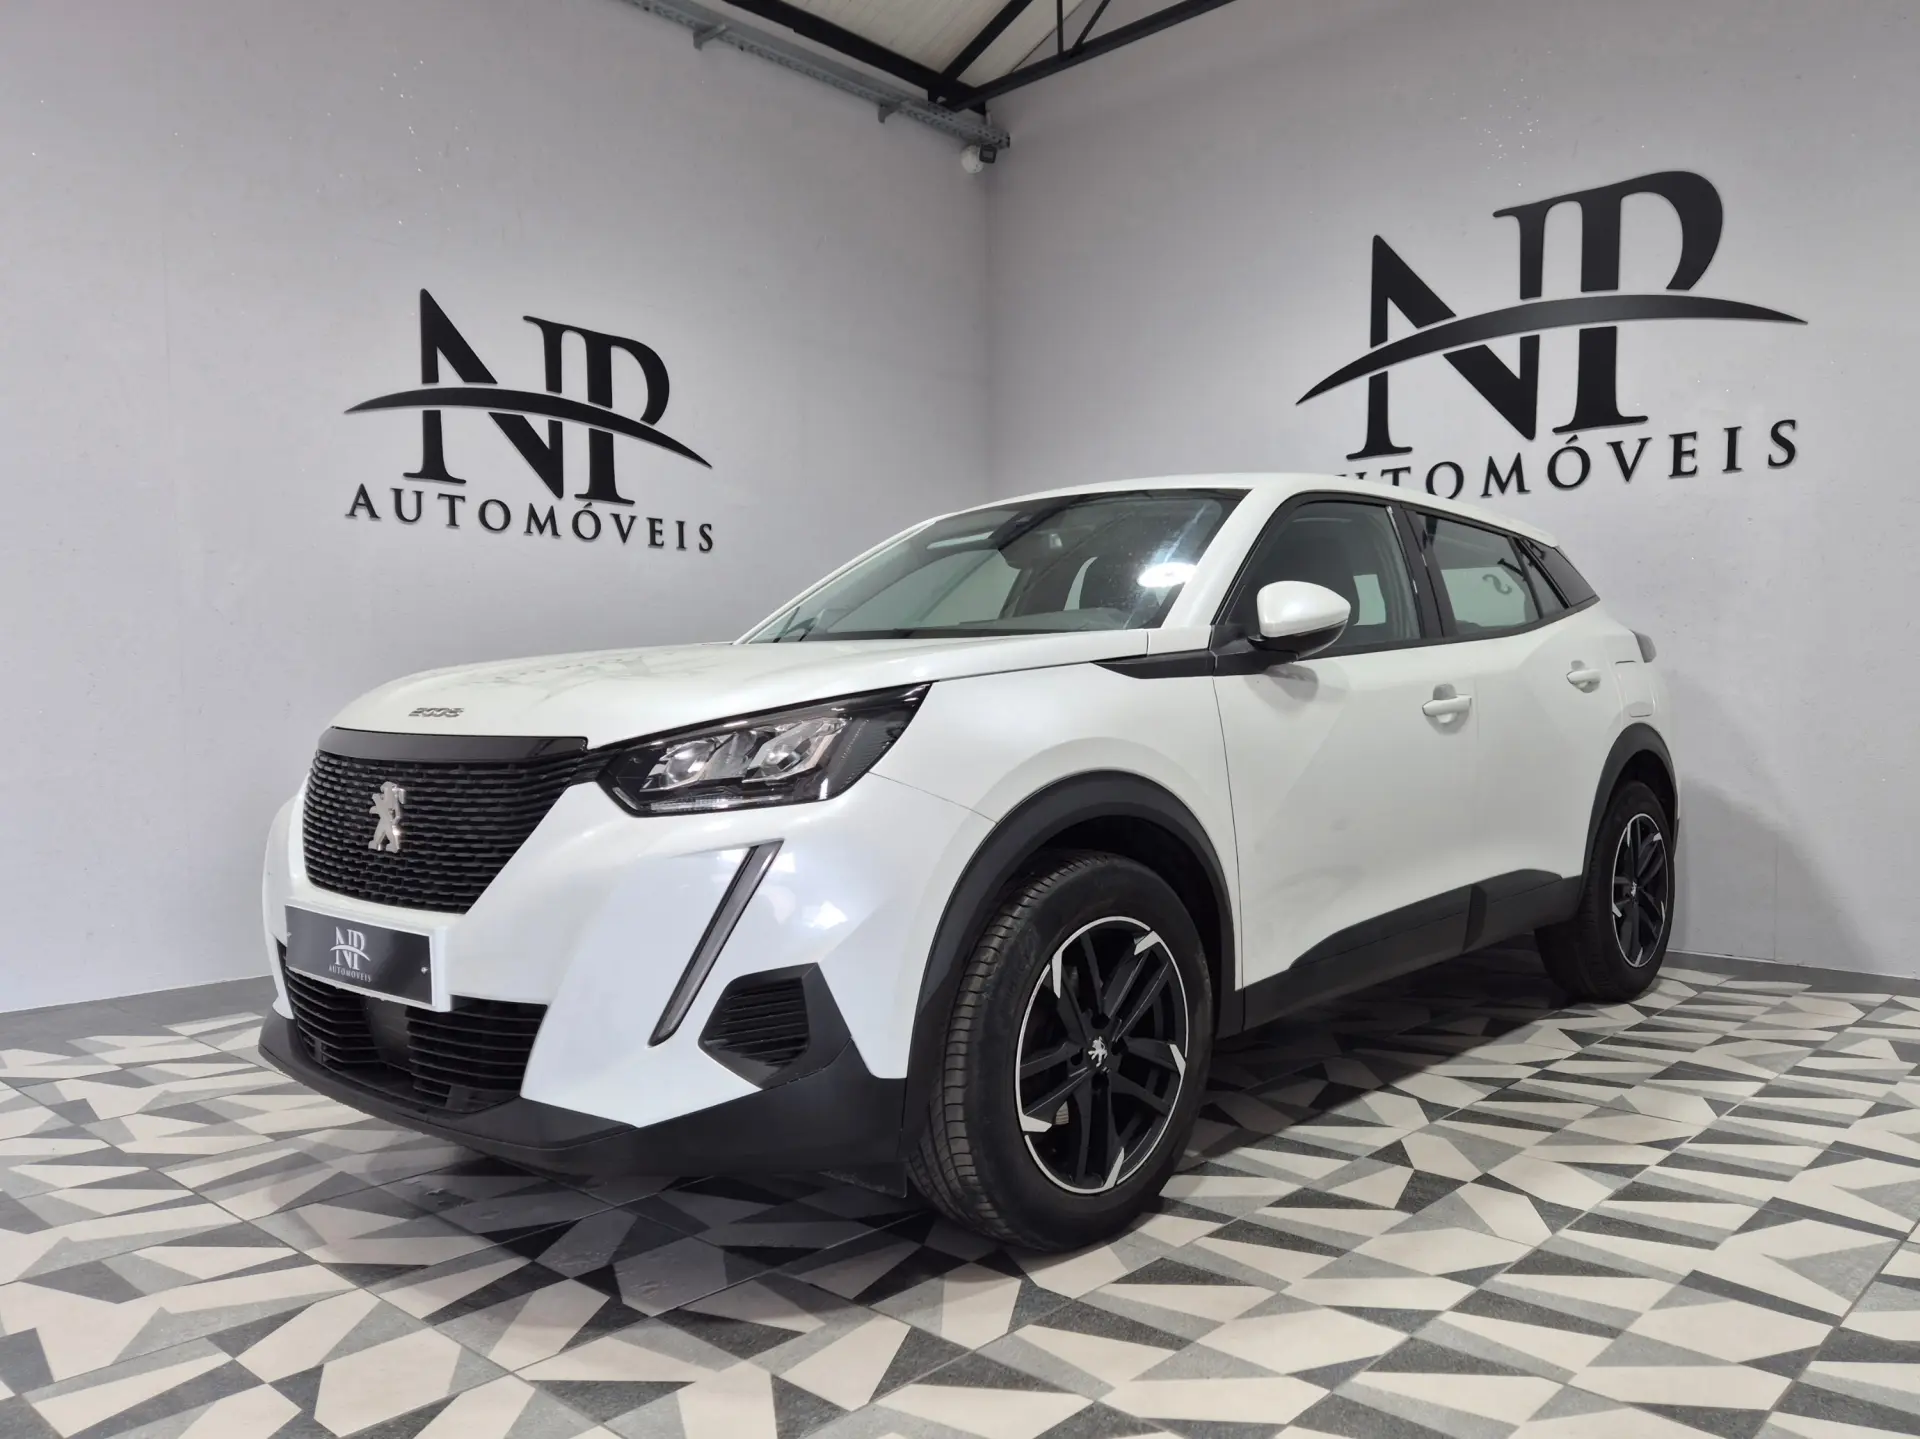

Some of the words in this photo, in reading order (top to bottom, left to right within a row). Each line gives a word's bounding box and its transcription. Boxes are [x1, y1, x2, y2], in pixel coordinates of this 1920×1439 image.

[1346, 170, 1724, 460] NP
[403, 288, 670, 505] NP
[345, 483, 714, 553] AUTOMÓVEIS
[335, 926, 365, 971] NP
